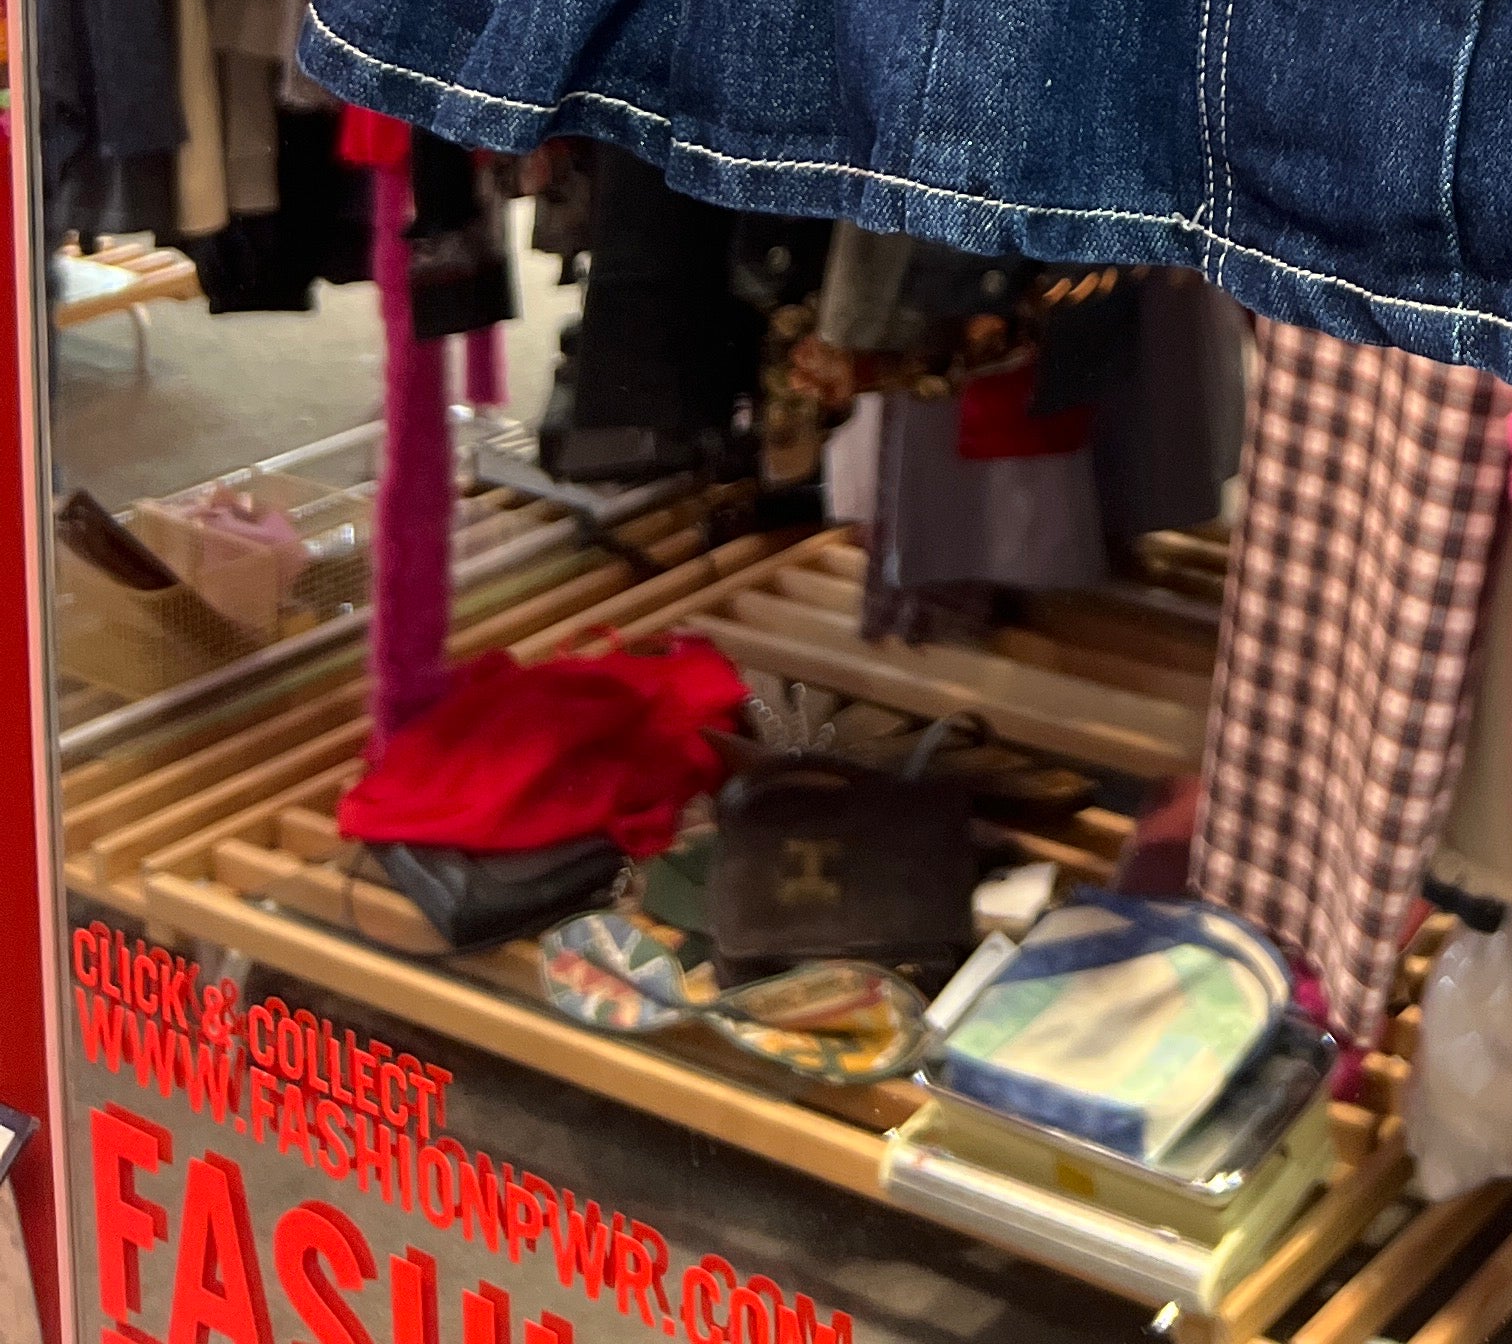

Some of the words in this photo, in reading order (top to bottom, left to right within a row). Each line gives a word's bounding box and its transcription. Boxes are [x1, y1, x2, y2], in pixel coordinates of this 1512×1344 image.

[73, 927, 188, 1030] CLICK
[202, 985, 233, 1047] &
[248, 1004, 437, 1139] COLLECT
[90, 1107, 560, 1344] FAS
